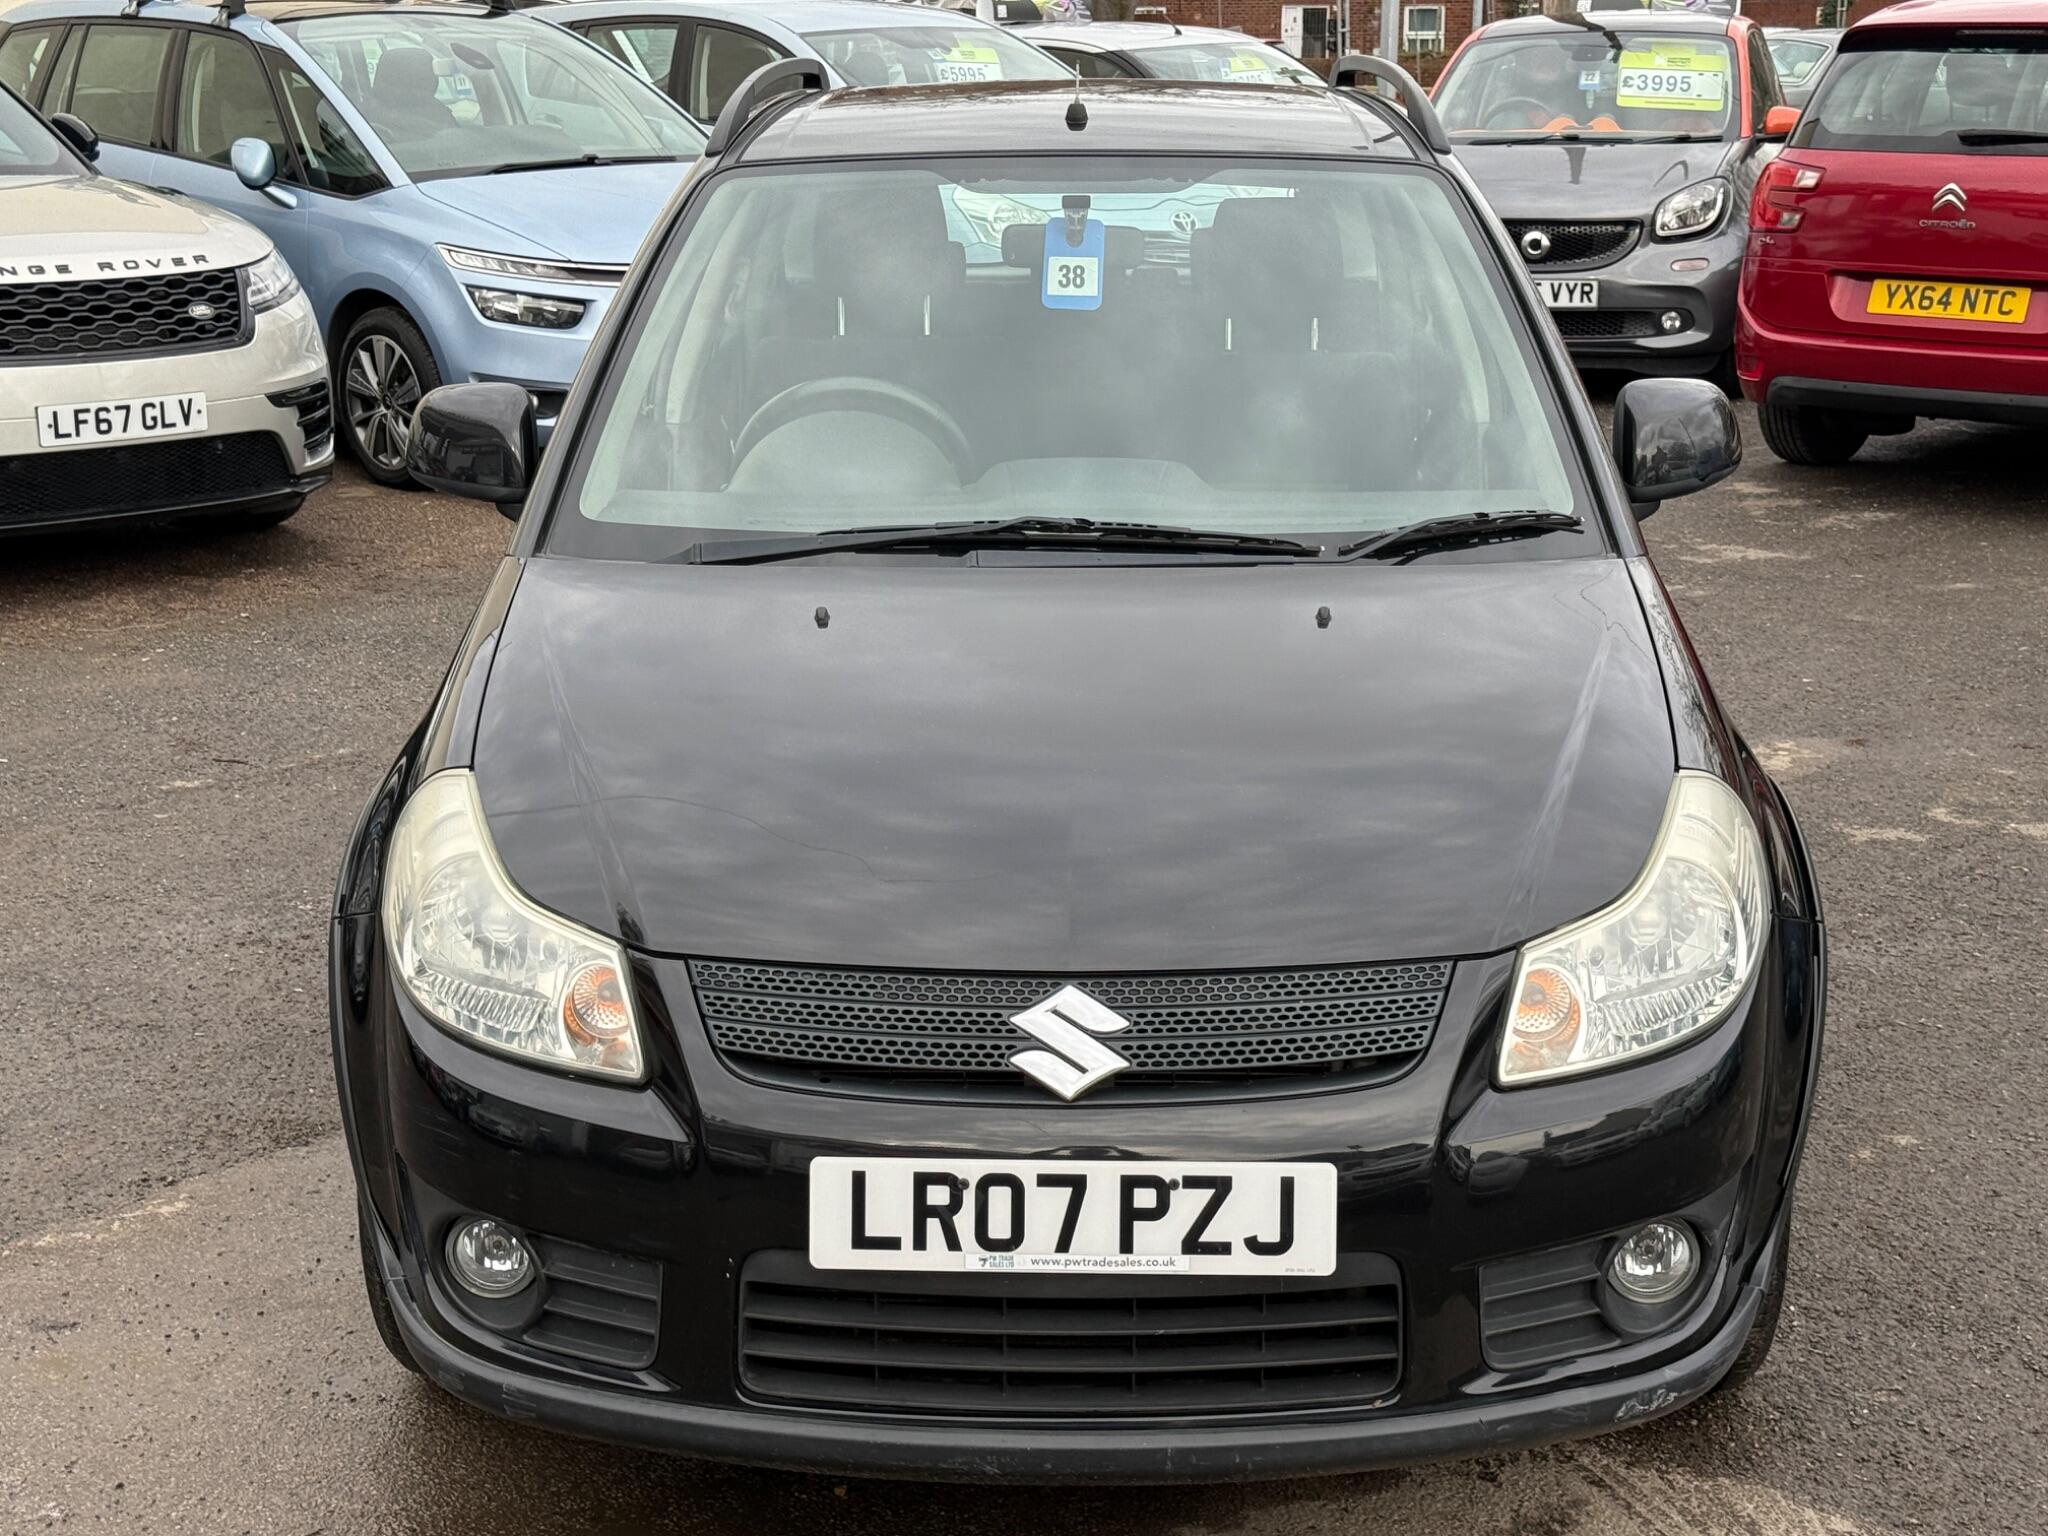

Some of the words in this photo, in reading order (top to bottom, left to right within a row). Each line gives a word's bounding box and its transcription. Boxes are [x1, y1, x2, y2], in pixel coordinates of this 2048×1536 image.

[940, 66, 986, 82] £5995
[1622, 74, 1692, 92] £3995
[97, 254, 209, 272] ROVER
[1057, 264, 1086, 289] 38
[1549, 282, 1594, 304] VYR
[1886, 283, 1953, 312] YX64
[1960, 287, 2017, 316] NTC
[52, 403, 132, 441] LF67
[141, 398, 193, 431] GLV
[851, 1170, 1088, 1253] LR07
[1119, 1174, 1295, 1256] PZJ
[1031, 1257, 1176, 1269] www.pwtradesales.co.uk
